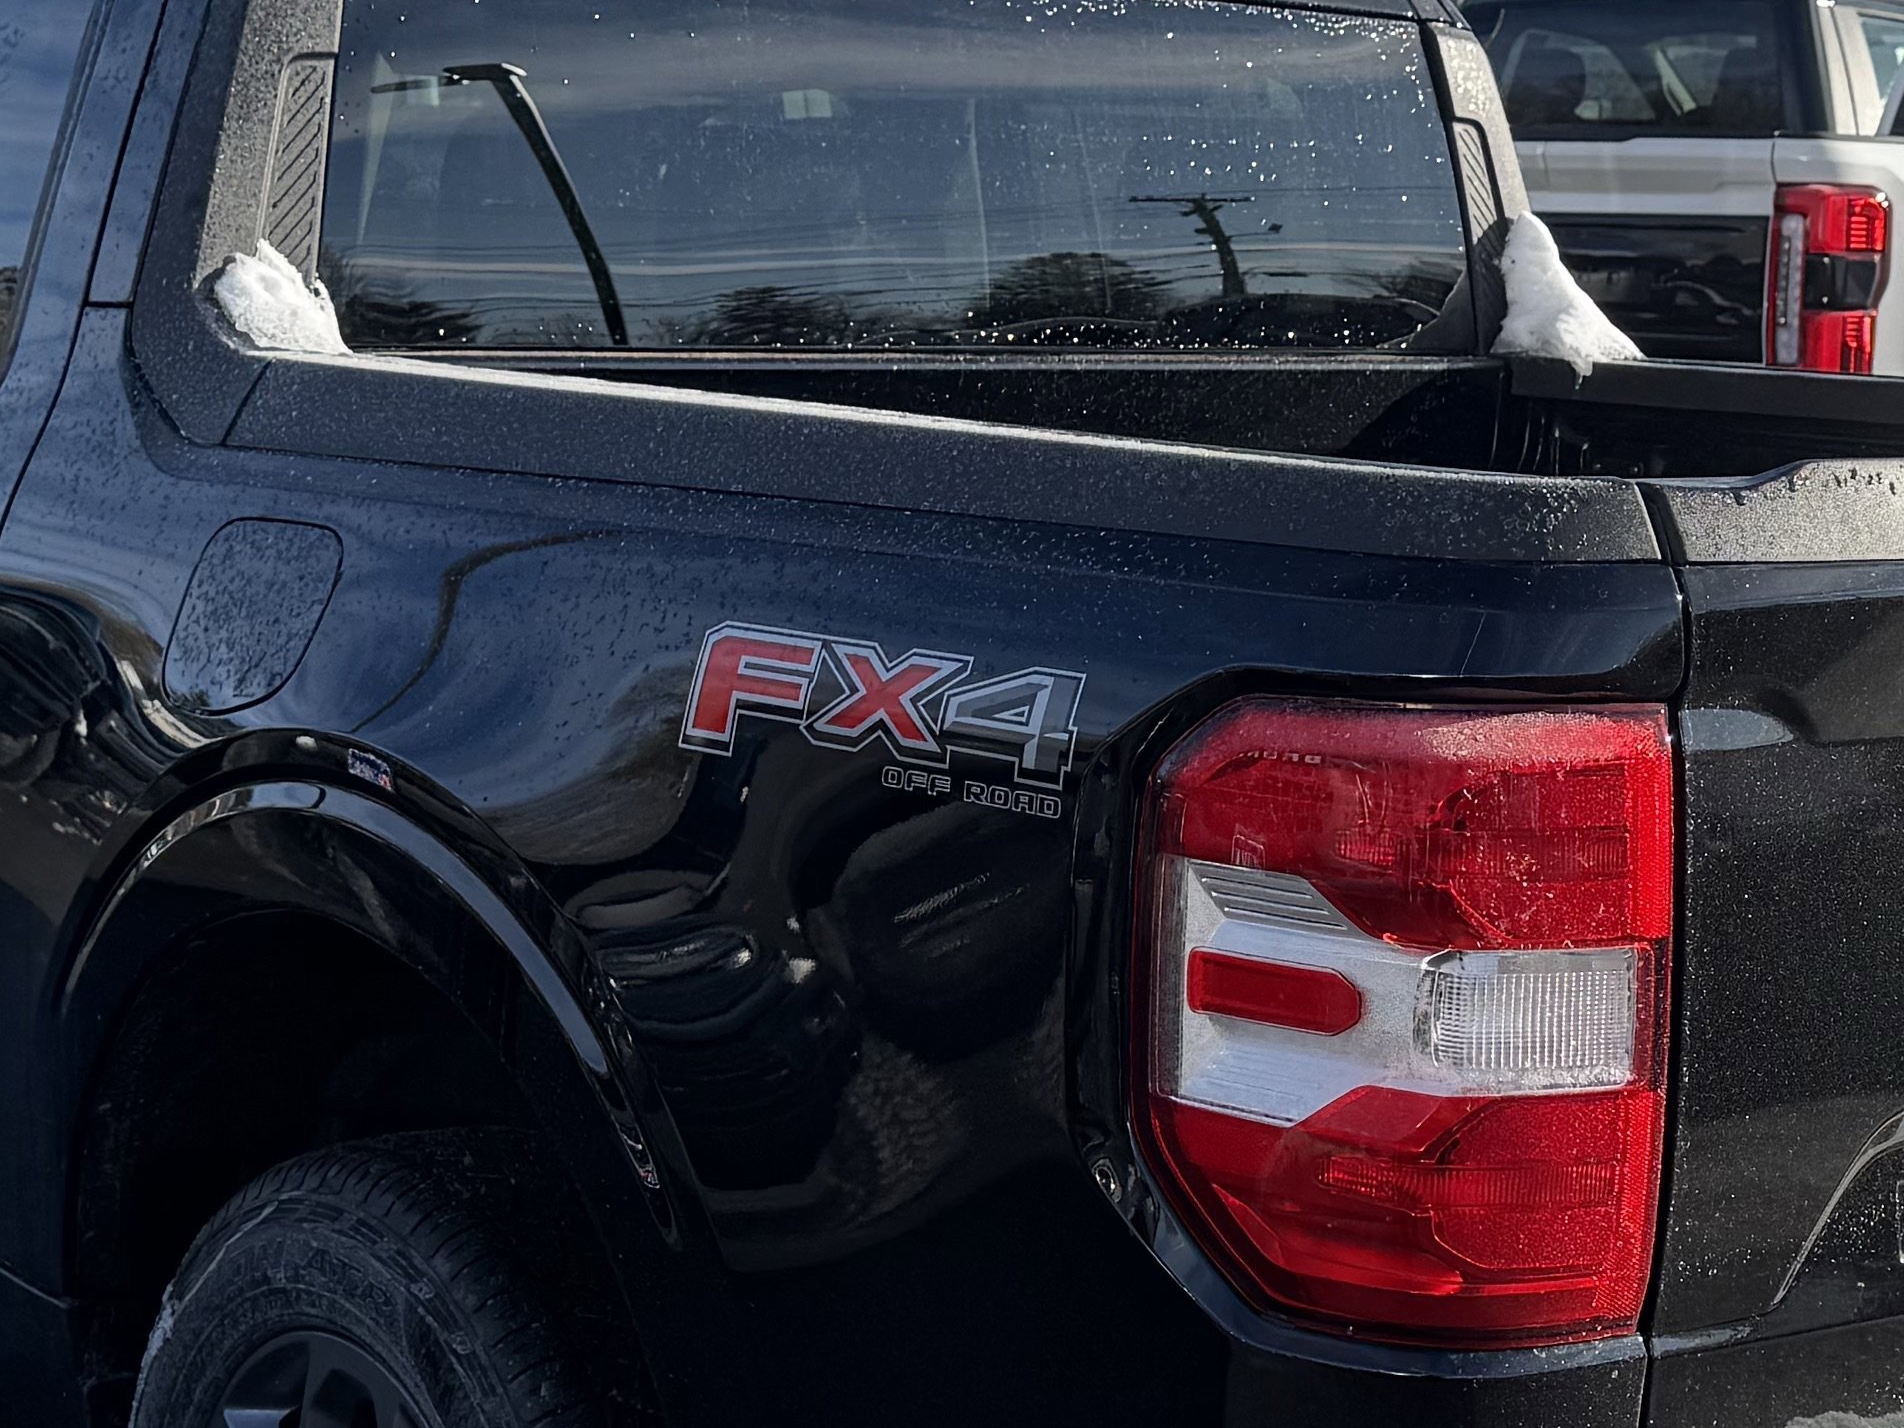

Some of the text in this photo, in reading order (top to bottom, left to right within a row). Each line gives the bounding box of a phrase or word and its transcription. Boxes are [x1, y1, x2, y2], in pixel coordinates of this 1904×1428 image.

[678, 620, 1088, 790] FX4
[881, 765, 1062, 820] OFF ROAD
